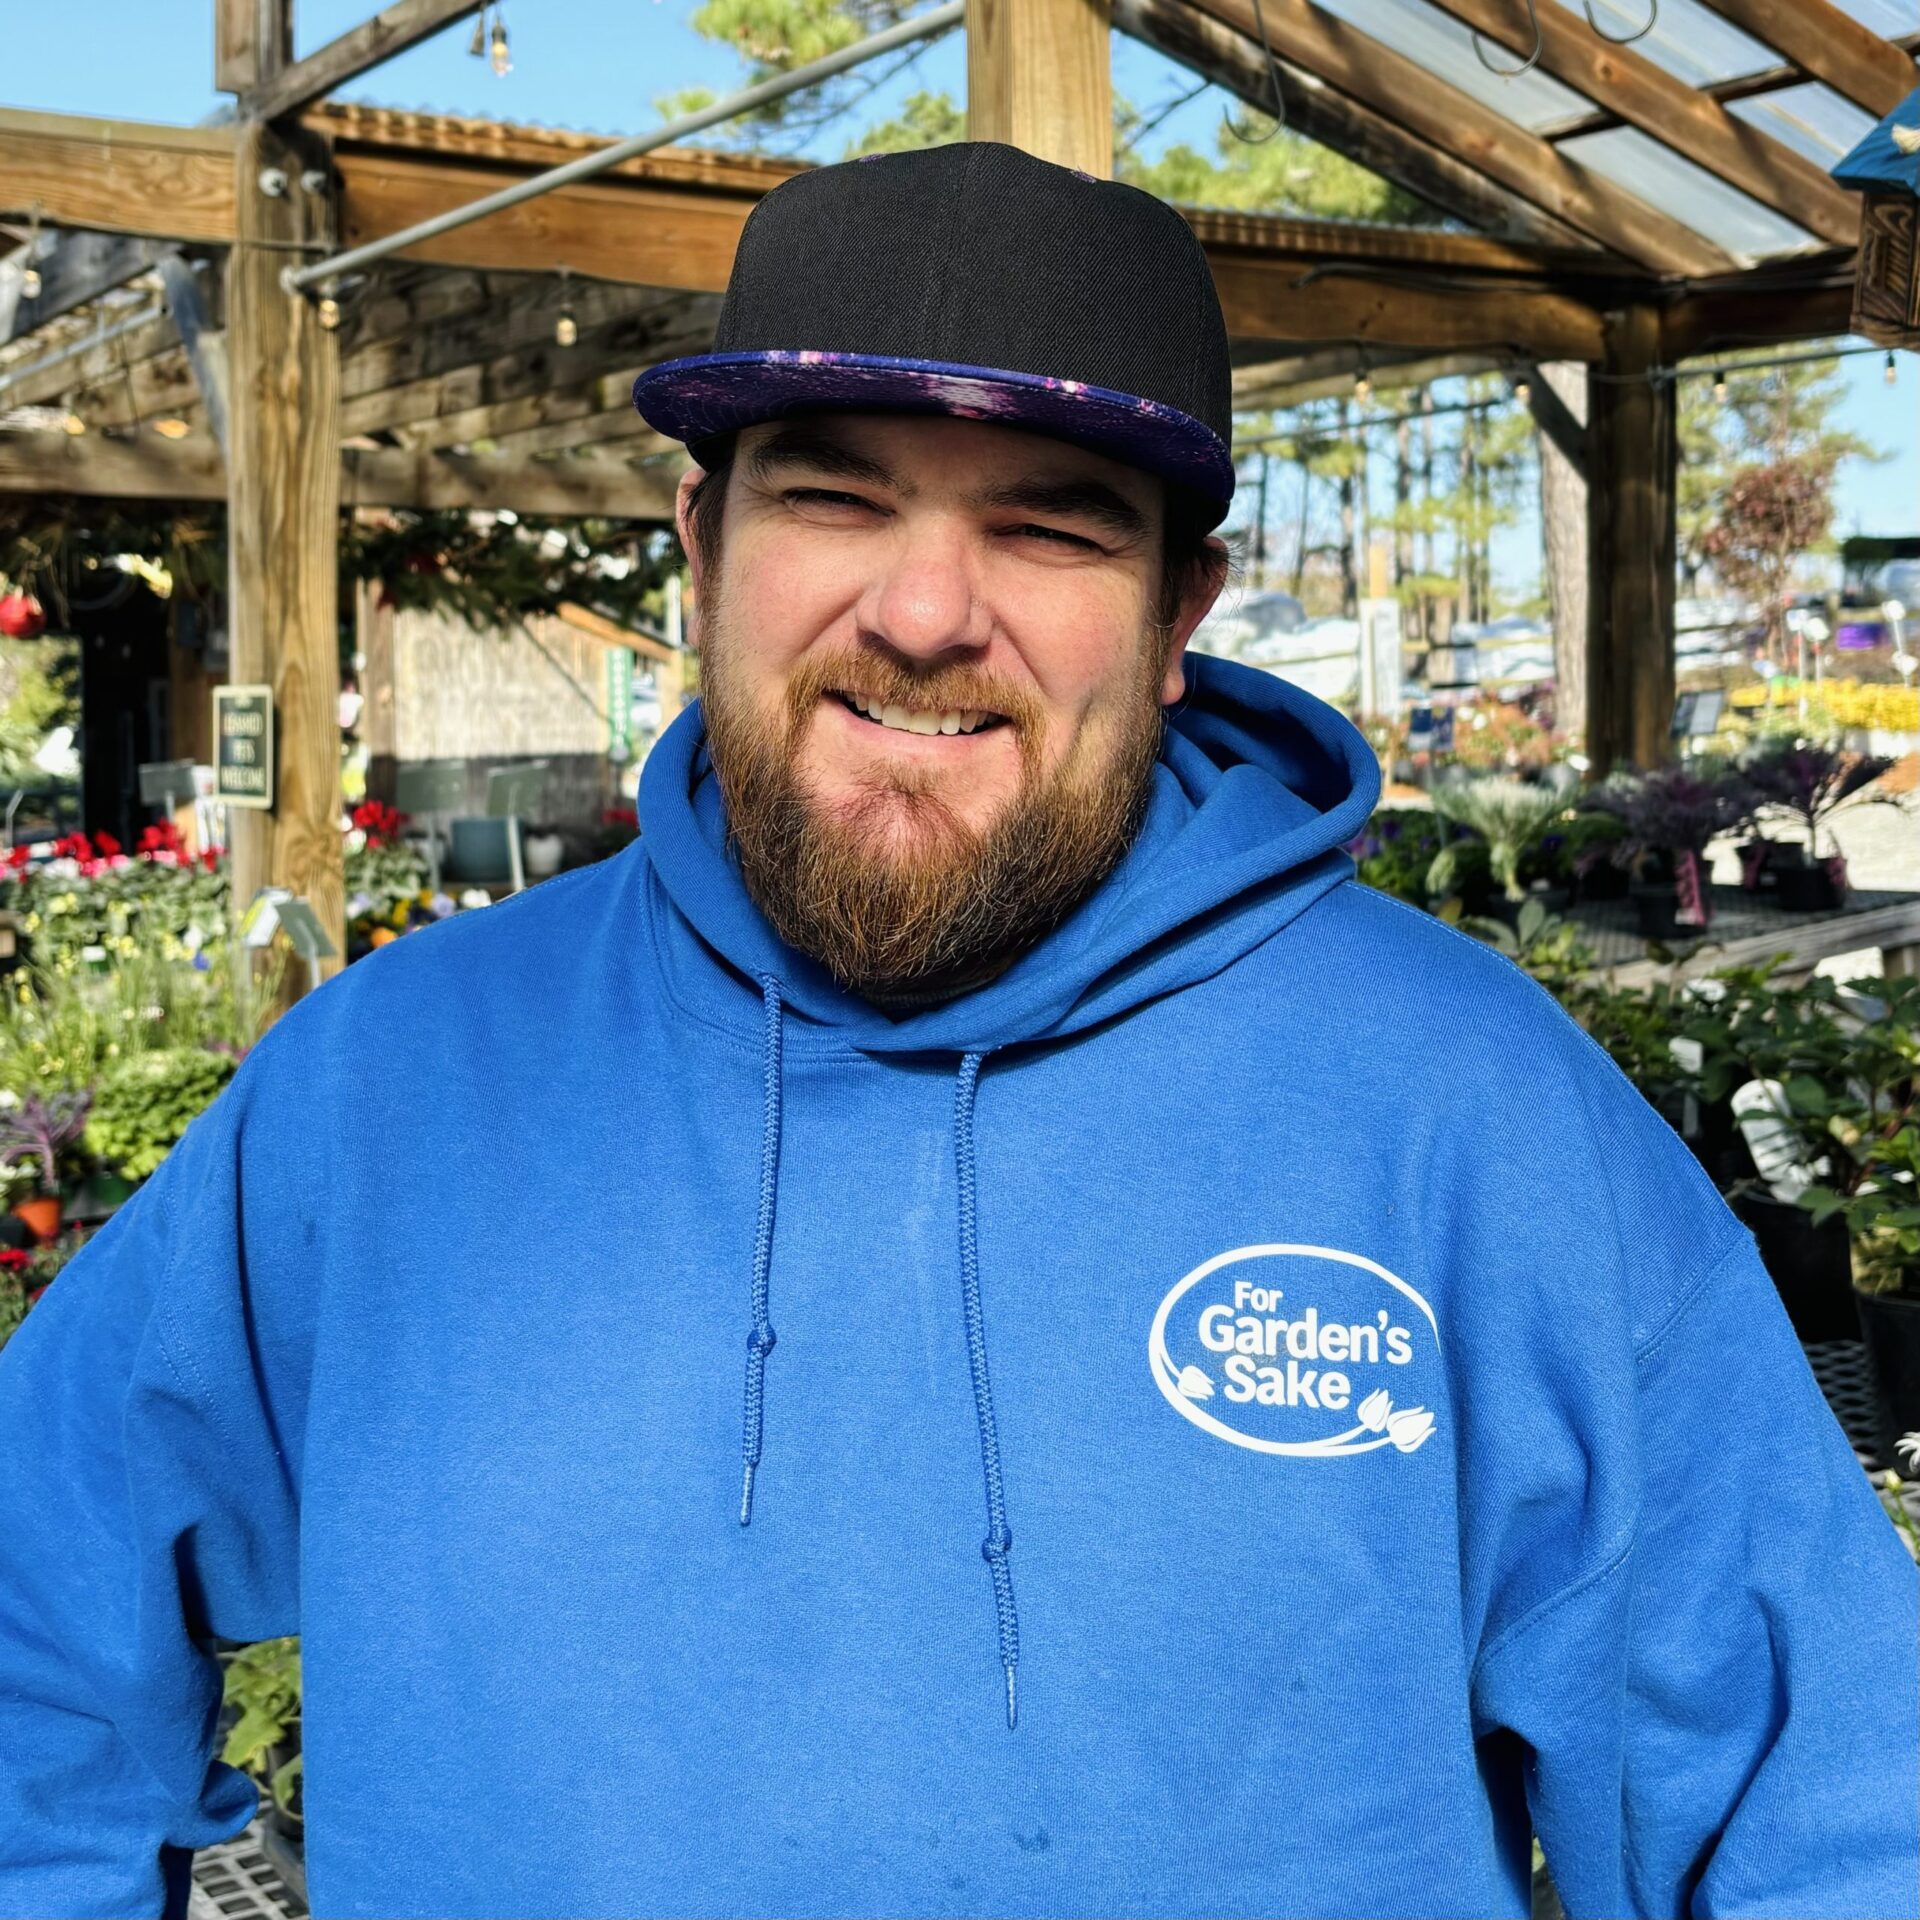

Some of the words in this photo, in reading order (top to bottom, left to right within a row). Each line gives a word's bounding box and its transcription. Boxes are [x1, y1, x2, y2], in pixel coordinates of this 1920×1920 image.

[221, 766, 264, 790] WELCOME
[1234, 1280, 1283, 1312] For
[1198, 1304, 1413, 1365] Garden's
[1223, 1354, 1351, 1410] Sake
